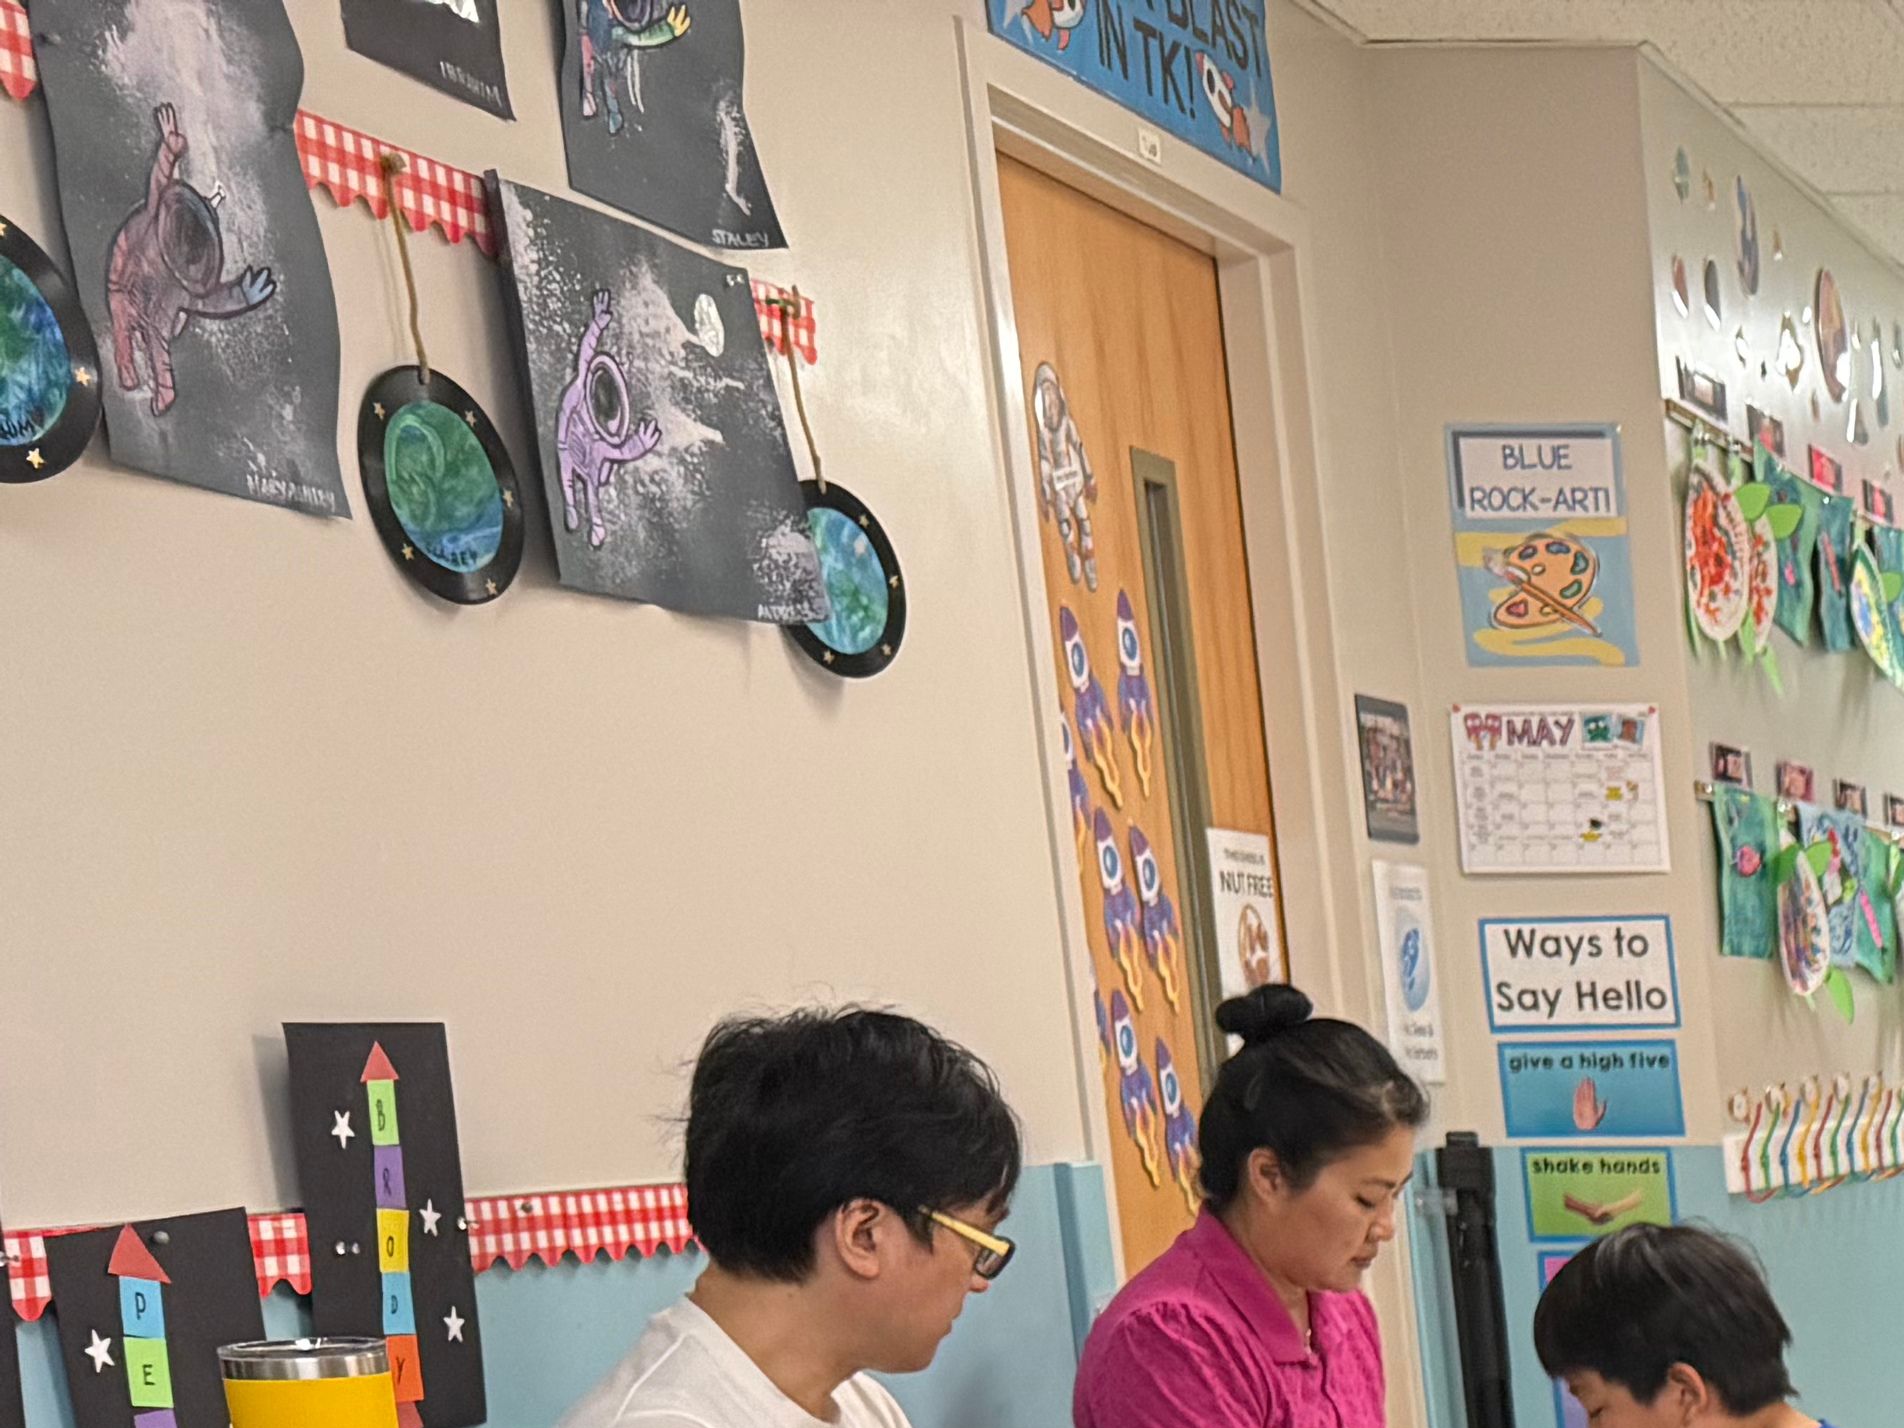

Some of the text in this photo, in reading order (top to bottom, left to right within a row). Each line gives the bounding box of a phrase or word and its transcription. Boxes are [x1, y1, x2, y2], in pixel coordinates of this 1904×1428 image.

[1133, 16, 1196, 120] TK!
[712, 228, 769, 248] STALEY
[1502, 444, 1573, 471] BLUE
[1506, 717, 1576, 747] MAY
[1219, 869, 1274, 899] NUT FREE
[1502, 926, 1650, 966] Ways to
[1495, 979, 1668, 1018] Say Hello
[1508, 1051, 1671, 1074] give a high five
[1531, 1156, 1662, 1175] shake hands
